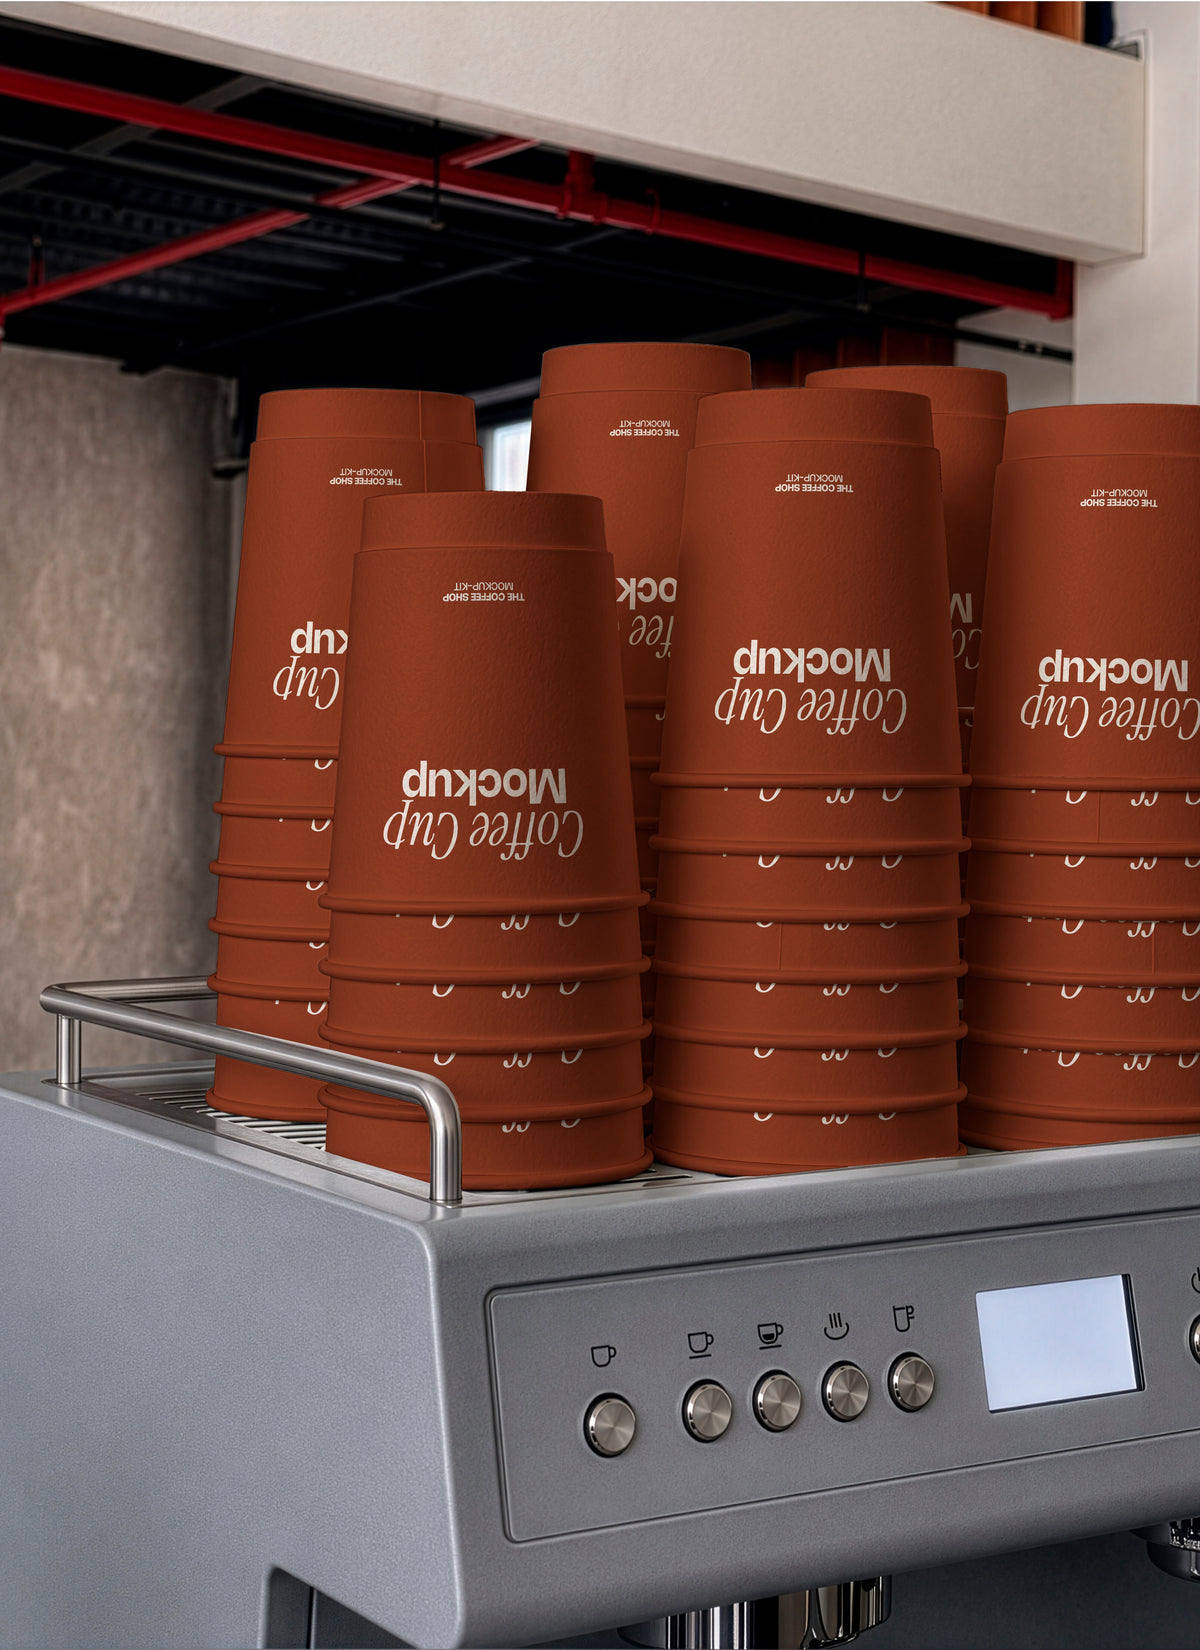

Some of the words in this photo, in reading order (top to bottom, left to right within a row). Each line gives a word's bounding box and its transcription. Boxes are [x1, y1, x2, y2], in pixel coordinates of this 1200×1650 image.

[618, 419, 671, 428] MOCKUP-KIT
[609, 428, 633, 437] SHOP
[632, 428, 664, 437] COFFEE
[663, 428, 681, 437] THE
[338, 467, 393, 477] MOCKUP-KIT
[329, 476, 354, 486] SHOP
[353, 476, 386, 486] COFFEE
[386, 477, 403, 487] THE
[785, 473, 844, 484] MOCKUP-KIT
[774, 483, 801, 493] SHOP
[801, 483, 836, 493] COFFEE
[836, 483, 855, 494] THE
[1090, 488, 1148, 498] MOCKUP-KIT
[1079, 498, 1106, 508] SHOP
[1105, 497, 1140, 508] COFFEE
[1140, 498, 1159, 509] THE
[452, 581, 514, 592] MOCKUP-KIT
[441, 592, 470, 603] SHOP
[470, 591, 506, 602] COFFEE
[506, 592, 526, 602] THE
[733, 639, 891, 684] Mockup
[1038, 648, 1189, 693] Mockup
[272, 655, 340, 710] Cup
[714, 676, 787, 735] Cup
[796, 687, 907, 736] Coffee
[1020, 683, 1090, 740] Cup
[1098, 696, 1200, 742] Coffee
[402, 759, 567, 806] Mockup
[382, 799, 459, 861] Cup
[469, 809, 584, 861] Coffee
